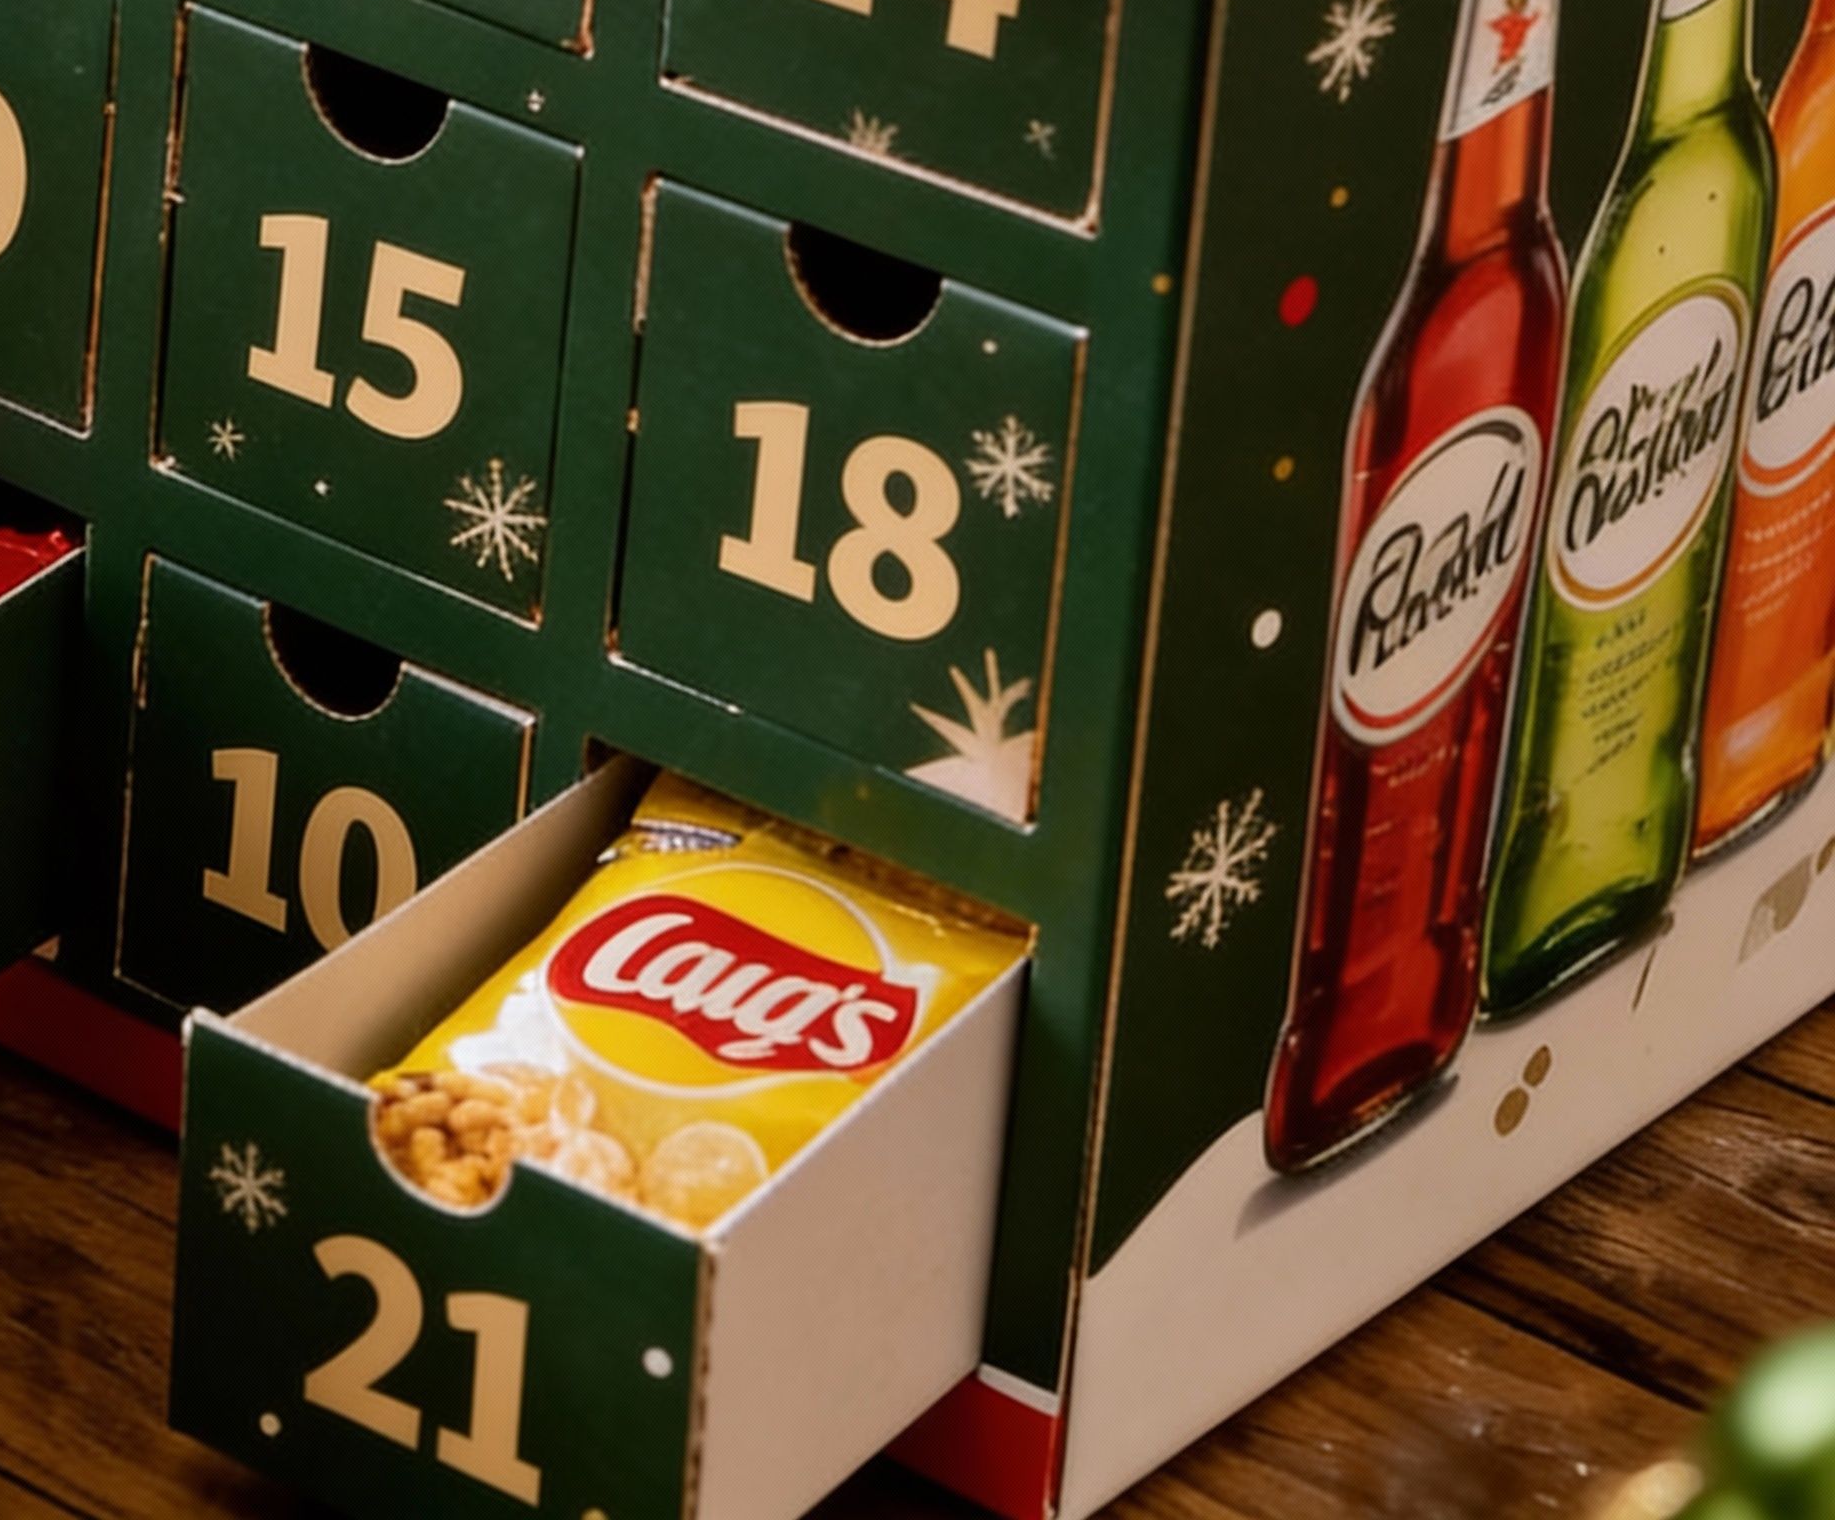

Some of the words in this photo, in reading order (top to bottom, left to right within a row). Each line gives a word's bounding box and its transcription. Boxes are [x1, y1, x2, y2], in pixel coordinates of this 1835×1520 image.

[247, 213, 466, 440] 15
[718, 400, 961, 641] 18
[204, 748, 418, 953] 10
[304, 1235, 541, 1506] 21
